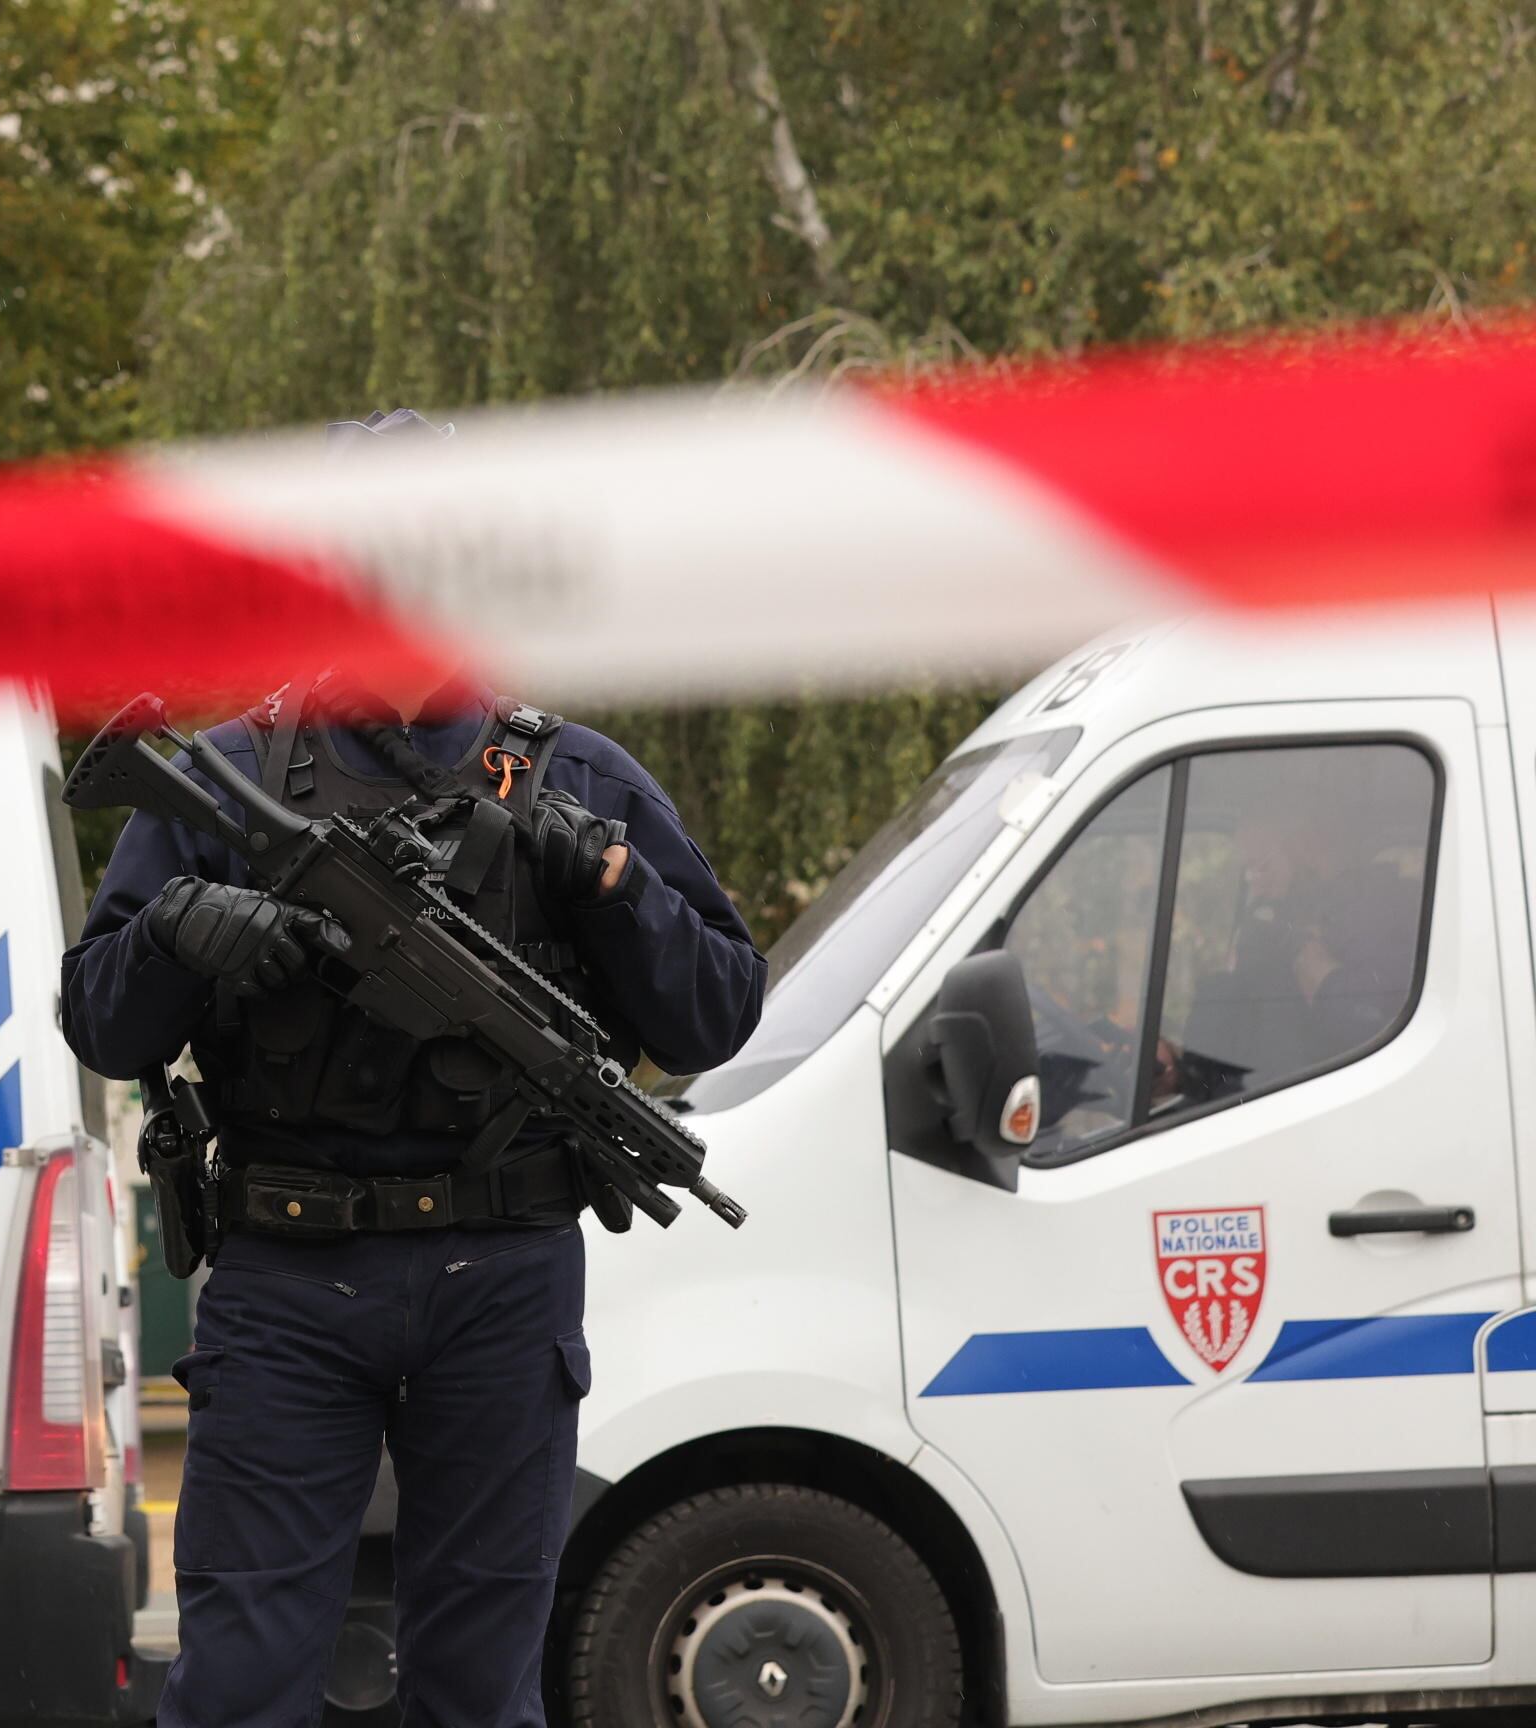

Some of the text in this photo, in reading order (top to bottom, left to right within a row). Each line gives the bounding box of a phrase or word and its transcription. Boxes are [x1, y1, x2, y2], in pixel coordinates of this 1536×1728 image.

[1170, 1216, 1249, 1234] POLICE
[1163, 1233, 1259, 1252] NATIONALE
[1164, 1257, 1260, 1300] CRS
